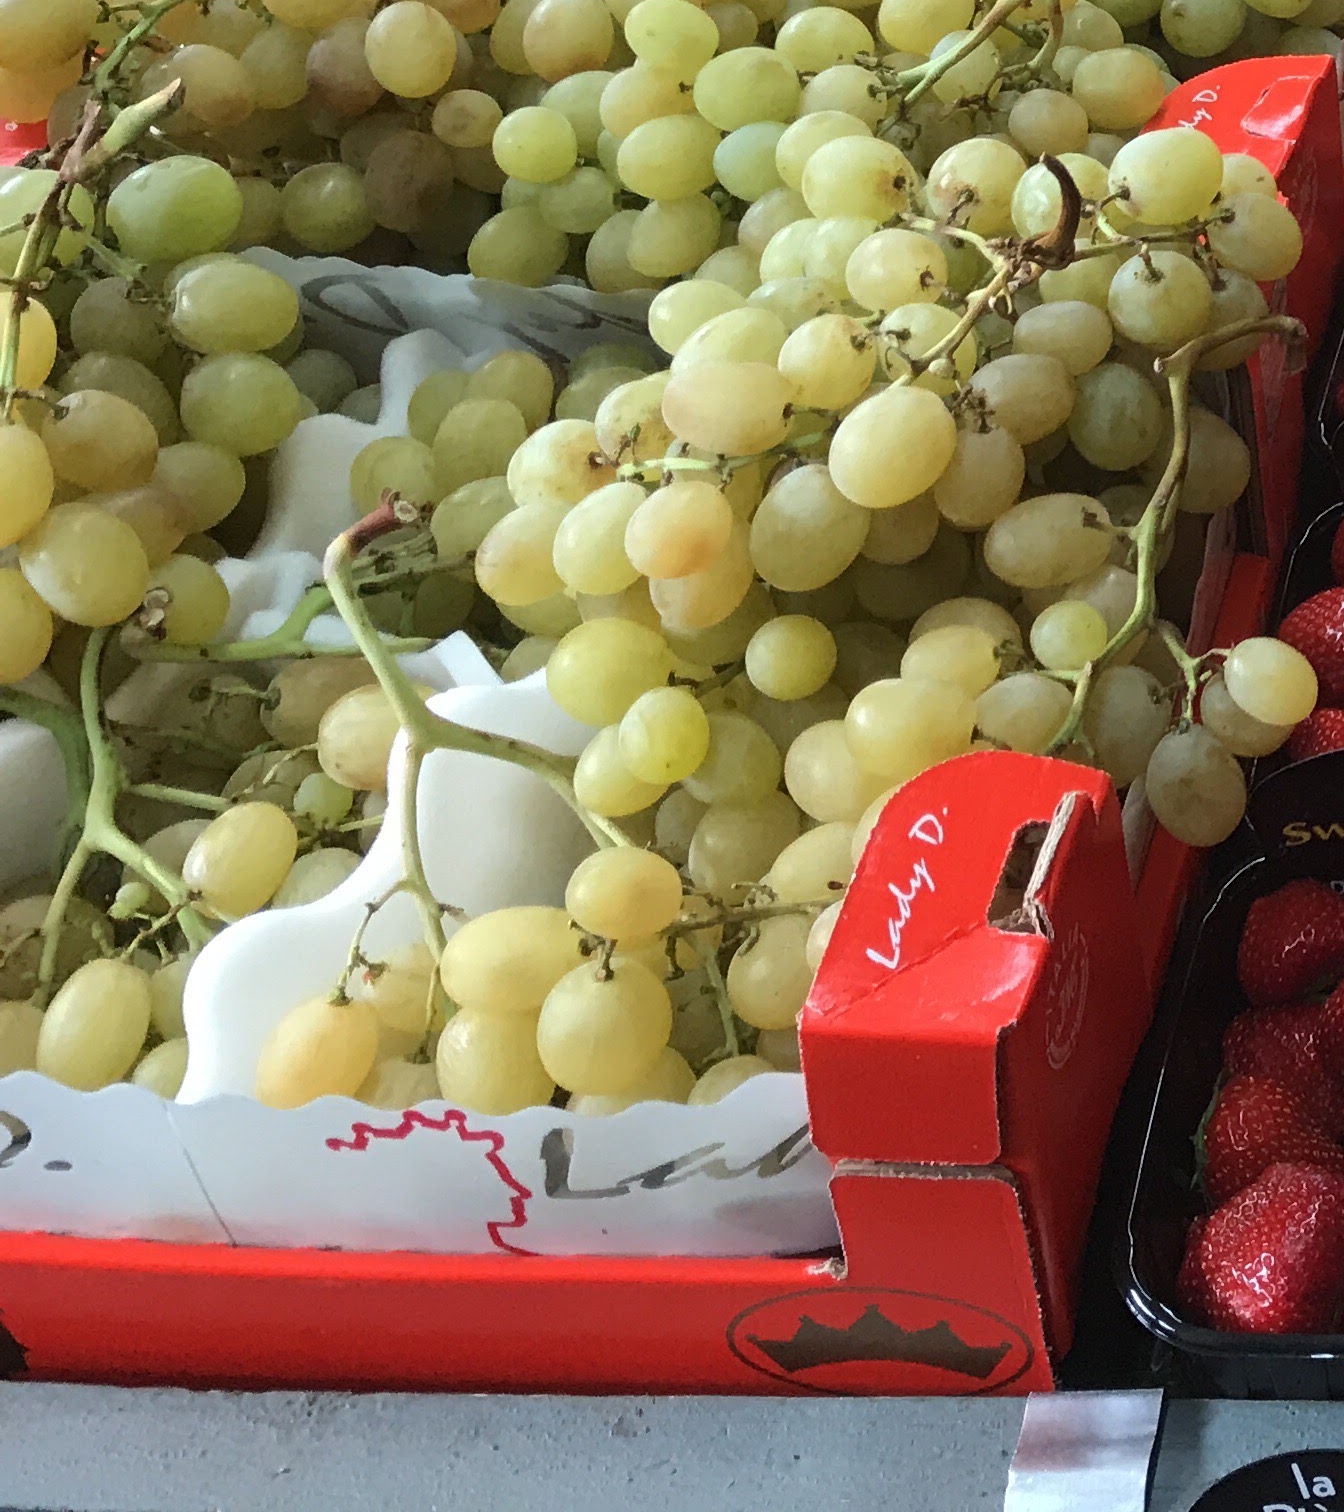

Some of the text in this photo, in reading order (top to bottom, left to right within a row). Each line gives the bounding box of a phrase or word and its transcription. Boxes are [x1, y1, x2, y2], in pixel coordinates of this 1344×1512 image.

[865, 806, 949, 970] Lady D.
[1291, 1462, 1337, 1500] la
